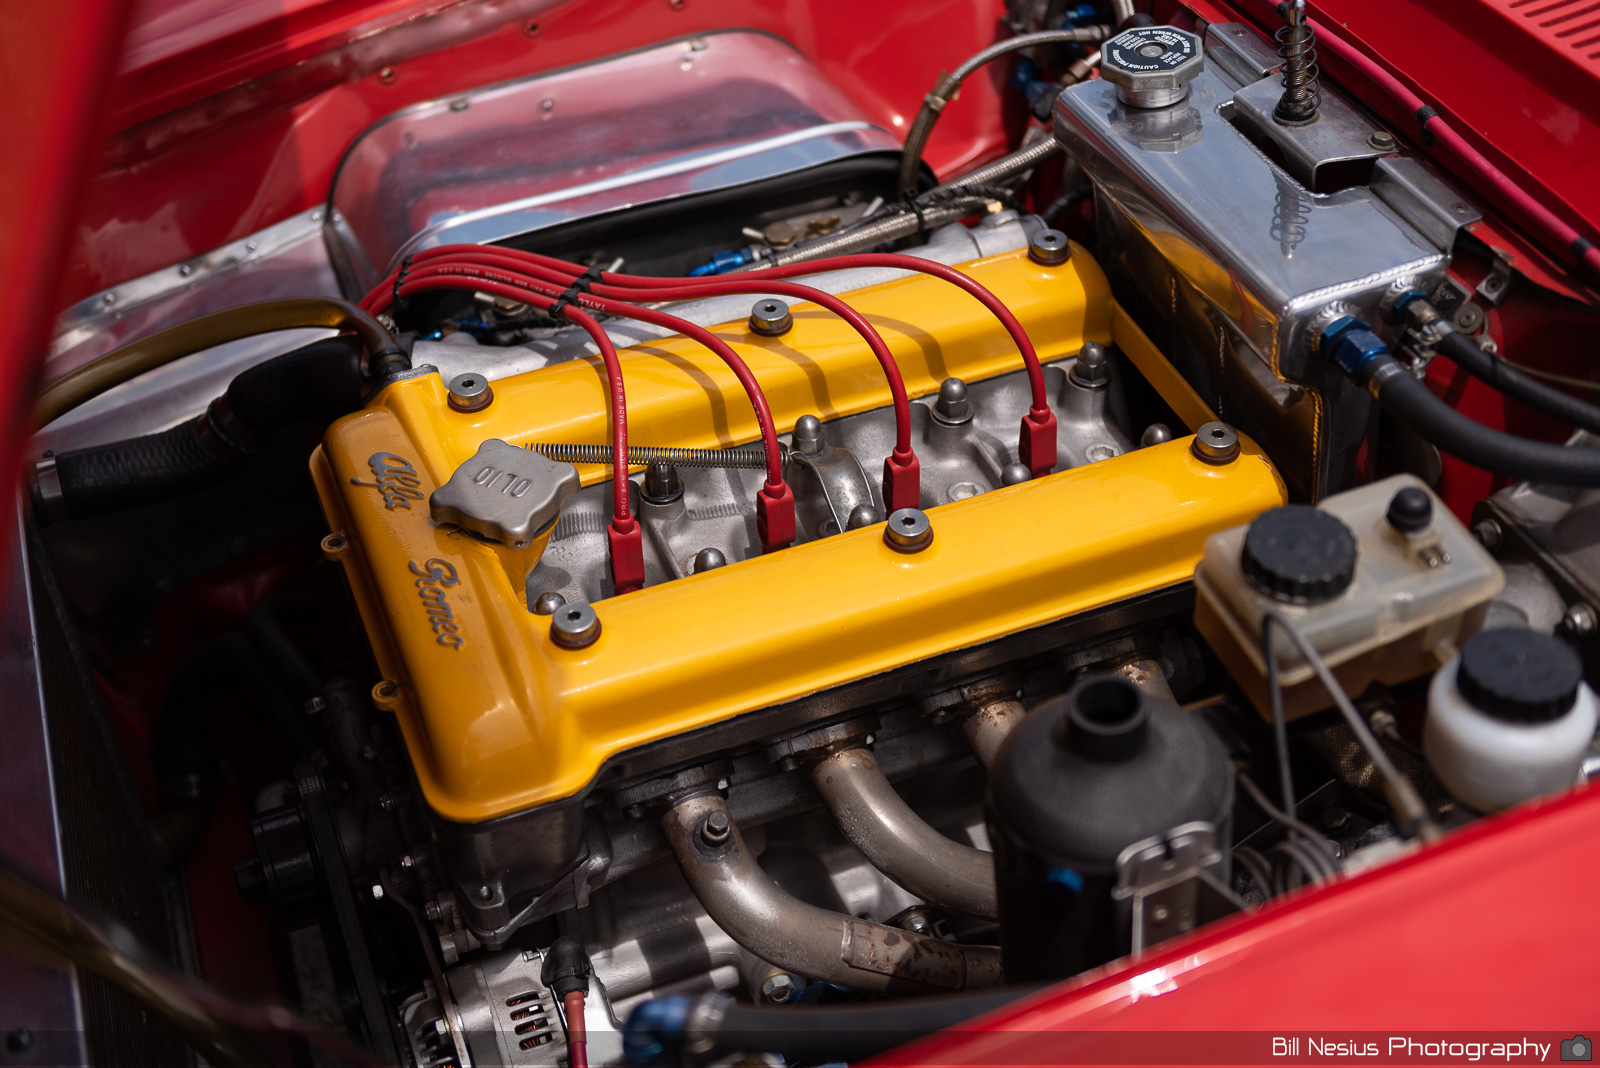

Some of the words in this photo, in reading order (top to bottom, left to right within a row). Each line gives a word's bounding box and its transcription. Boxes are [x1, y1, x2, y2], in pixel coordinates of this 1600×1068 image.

[463, 267, 481, 275] MADE
[484, 271, 513, 284] SILICONE
[578, 297, 606, 311] TAYLO
[474, 465, 534, 498] OLIO
[351, 452, 425, 511] Alfa
[408, 558, 464, 651] Romeo
